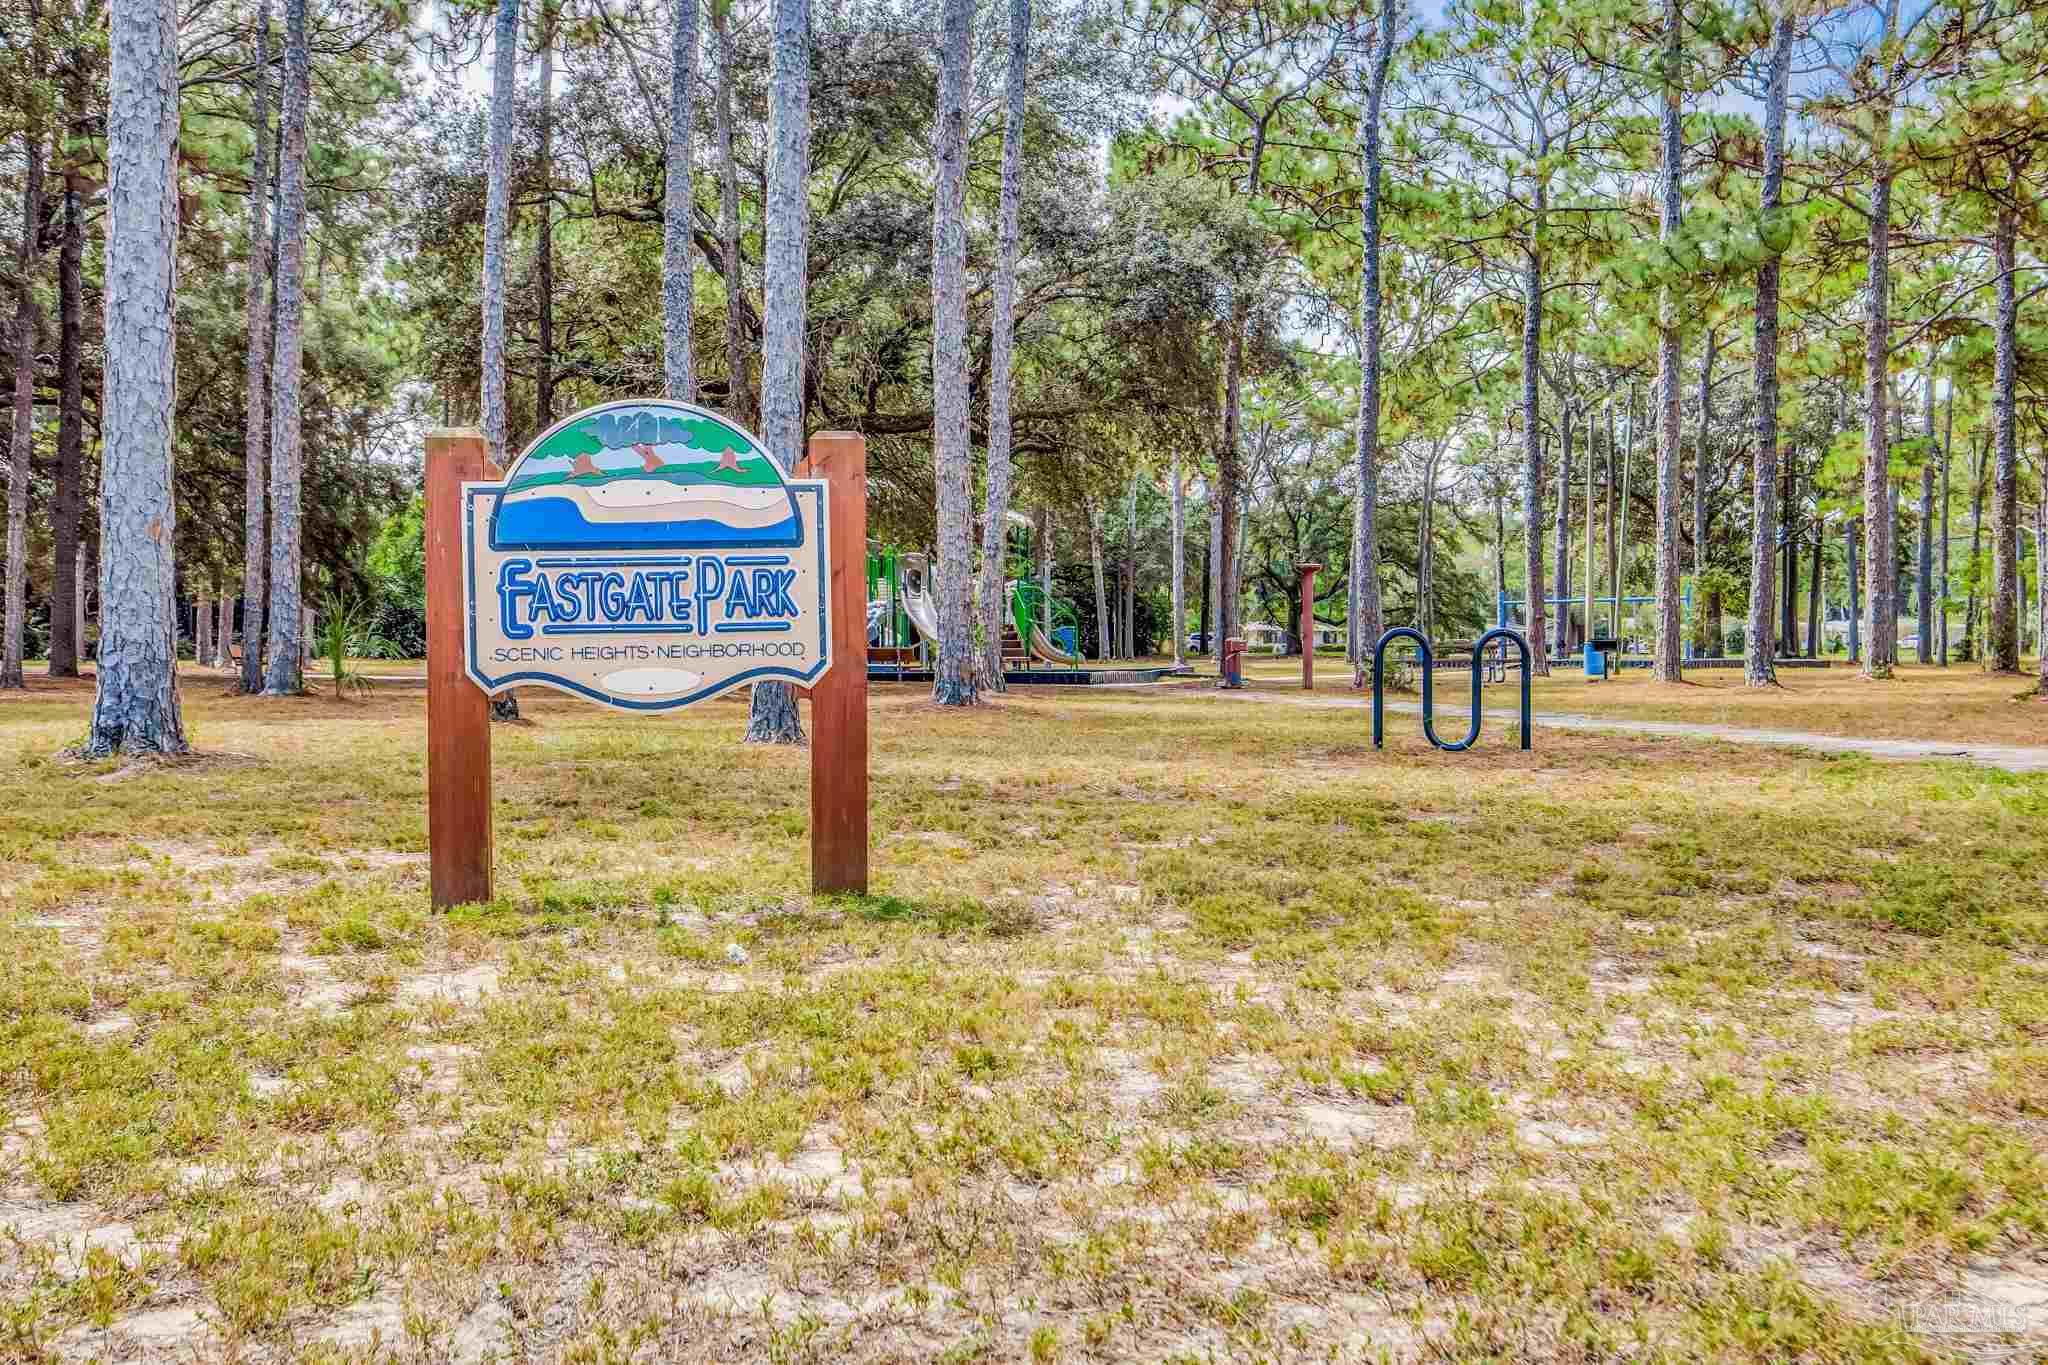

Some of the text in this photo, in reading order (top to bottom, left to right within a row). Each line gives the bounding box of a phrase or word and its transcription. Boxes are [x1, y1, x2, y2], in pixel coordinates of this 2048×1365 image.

[497, 556, 798, 639] EASTGATE PARK
[494, 643, 805, 662] SCENIC HEIGHTS NEIGHBORHOOD
